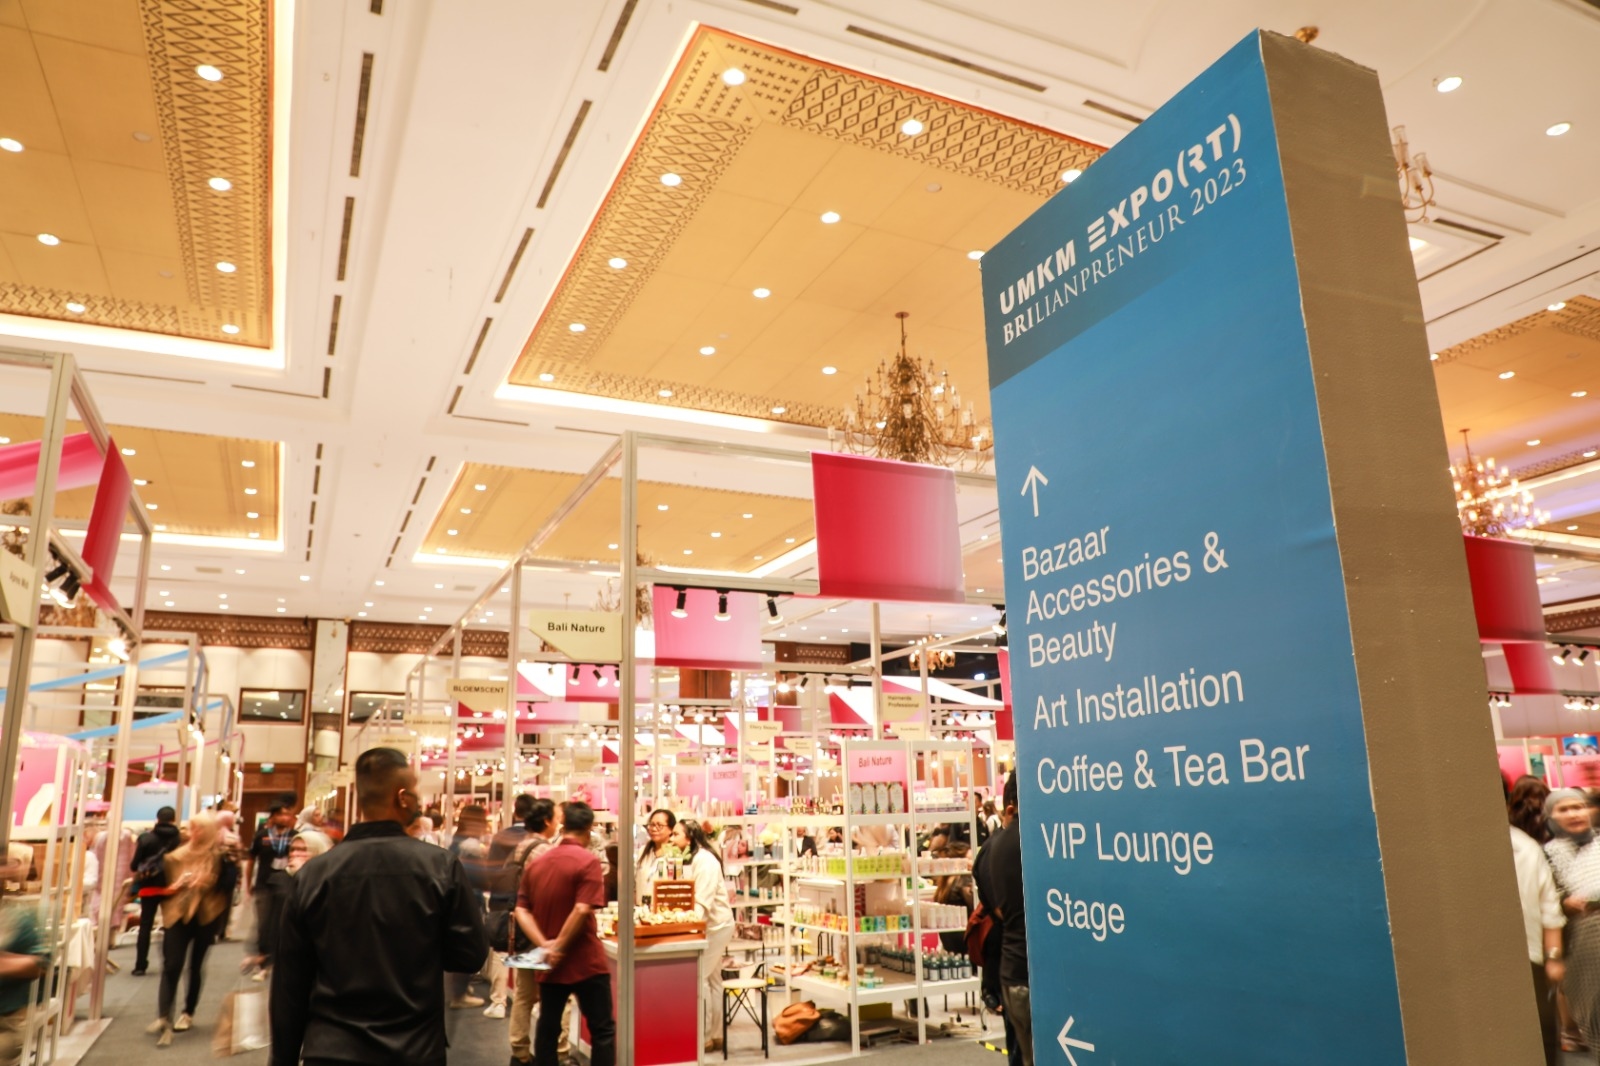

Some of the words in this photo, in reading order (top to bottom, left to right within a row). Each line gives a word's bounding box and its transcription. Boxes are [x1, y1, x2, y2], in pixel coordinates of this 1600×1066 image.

[1000, 239, 1076, 315] UMKM
[1003, 204, 1185, 346] BRILIANPRENEUR
[1191, 157, 1247, 216] 2023
[1022, 525, 1110, 581] Bazaar
[1026, 550, 1191, 625] Accessories
[1202, 531, 1229, 574] &
[547, 622, 568, 631] Bali
[571, 623, 605, 633] Nature
[1028, 620, 1117, 668] Beauty
[453, 685, 505, 694] BLOEMSCENT
[1033, 693, 1067, 731] Art
[1077, 668, 1244, 724] Installation
[858, 757, 870, 768] Bali
[872, 756, 892, 767] Nature
[1037, 754, 1123, 794] Coffee
[1134, 749, 1157, 789] &
[1164, 745, 1230, 787] Tea
[1239, 738, 1310, 783] Bar
[1041, 822, 1086, 859] VIP
[1095, 822, 1214, 875] Lounge
[1046, 888, 1125, 942] Stage
